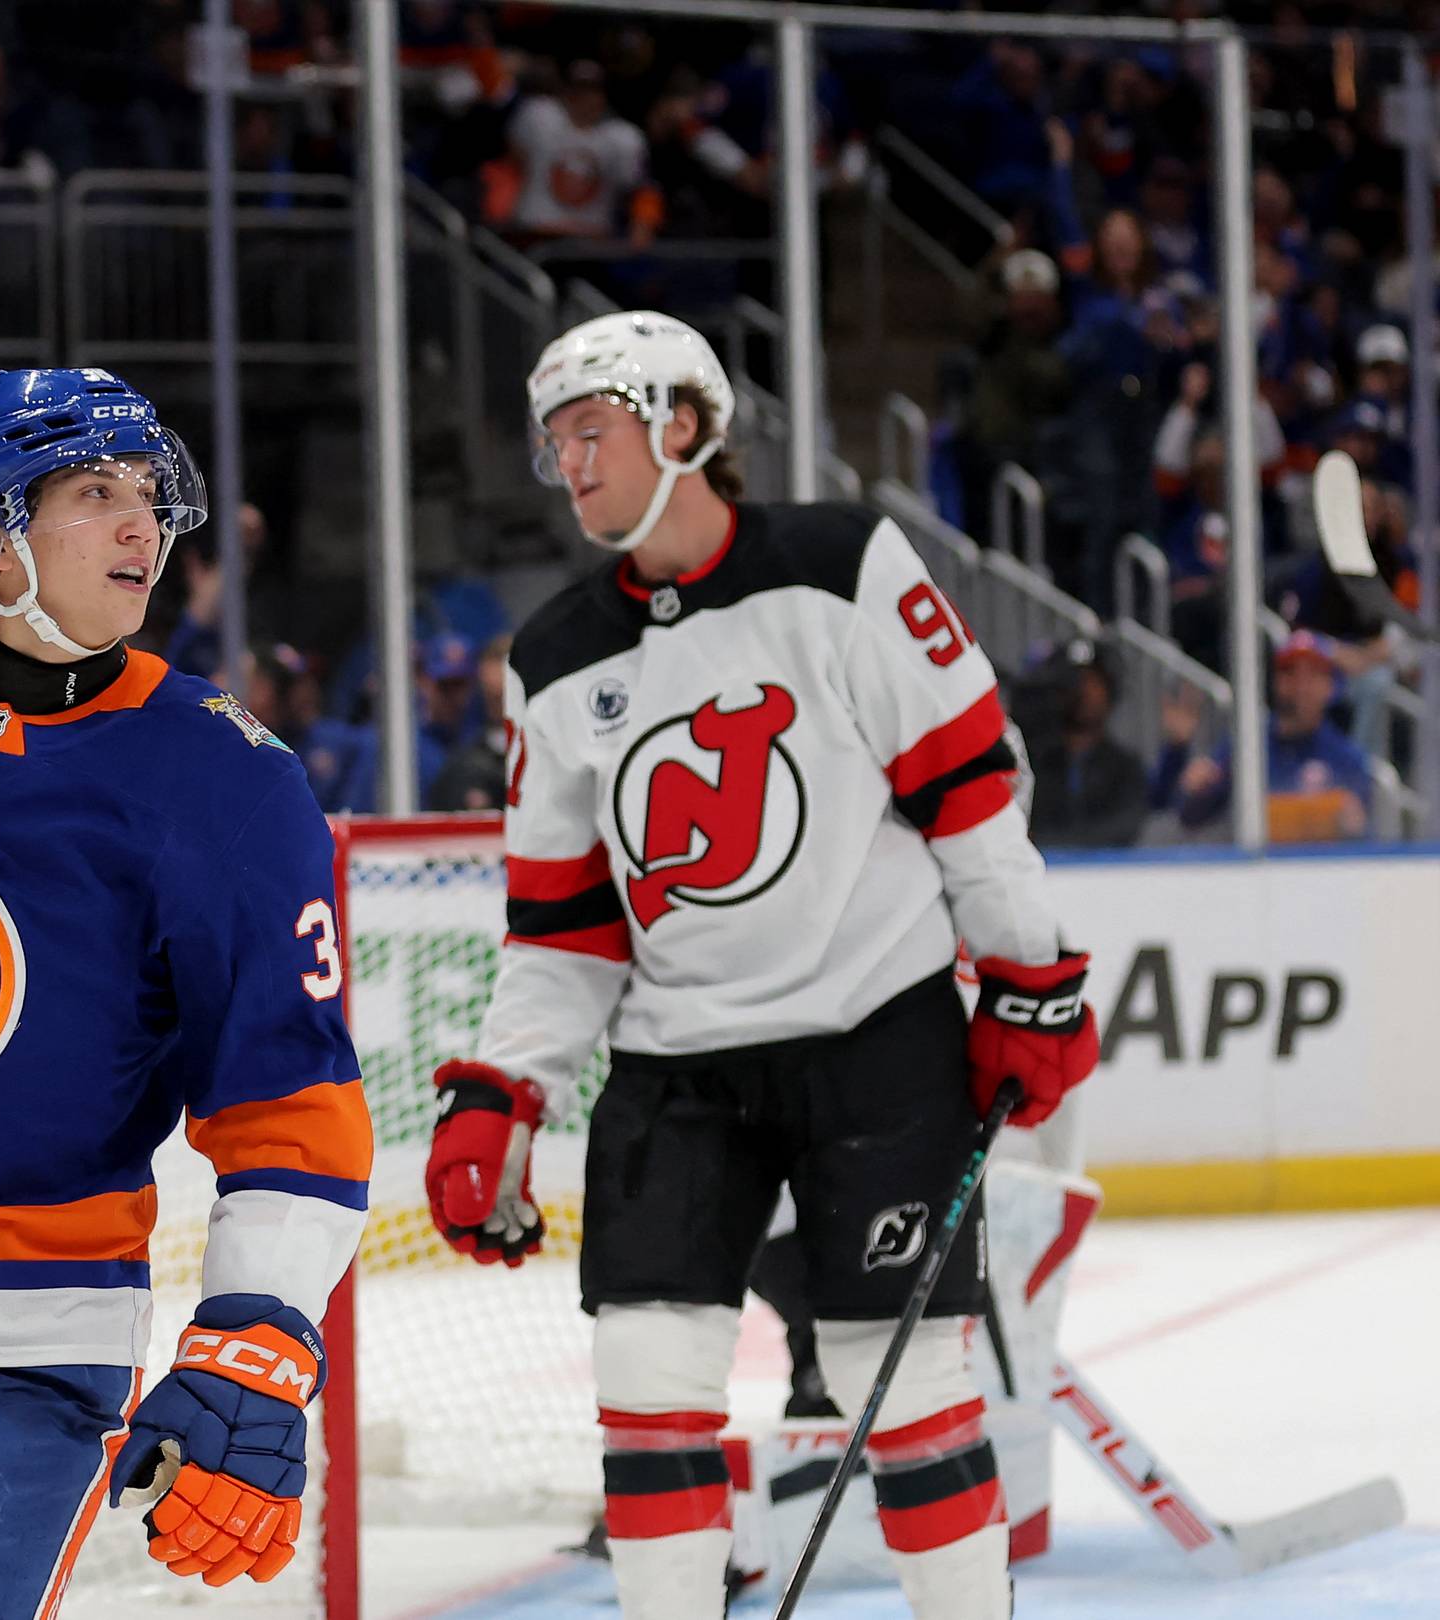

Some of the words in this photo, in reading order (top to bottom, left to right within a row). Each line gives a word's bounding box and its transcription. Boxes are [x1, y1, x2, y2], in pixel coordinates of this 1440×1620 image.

[92, 404, 146, 419] CCM
[301, 1330, 324, 1362] EKLUND
[175, 1333, 315, 1401] CCM
